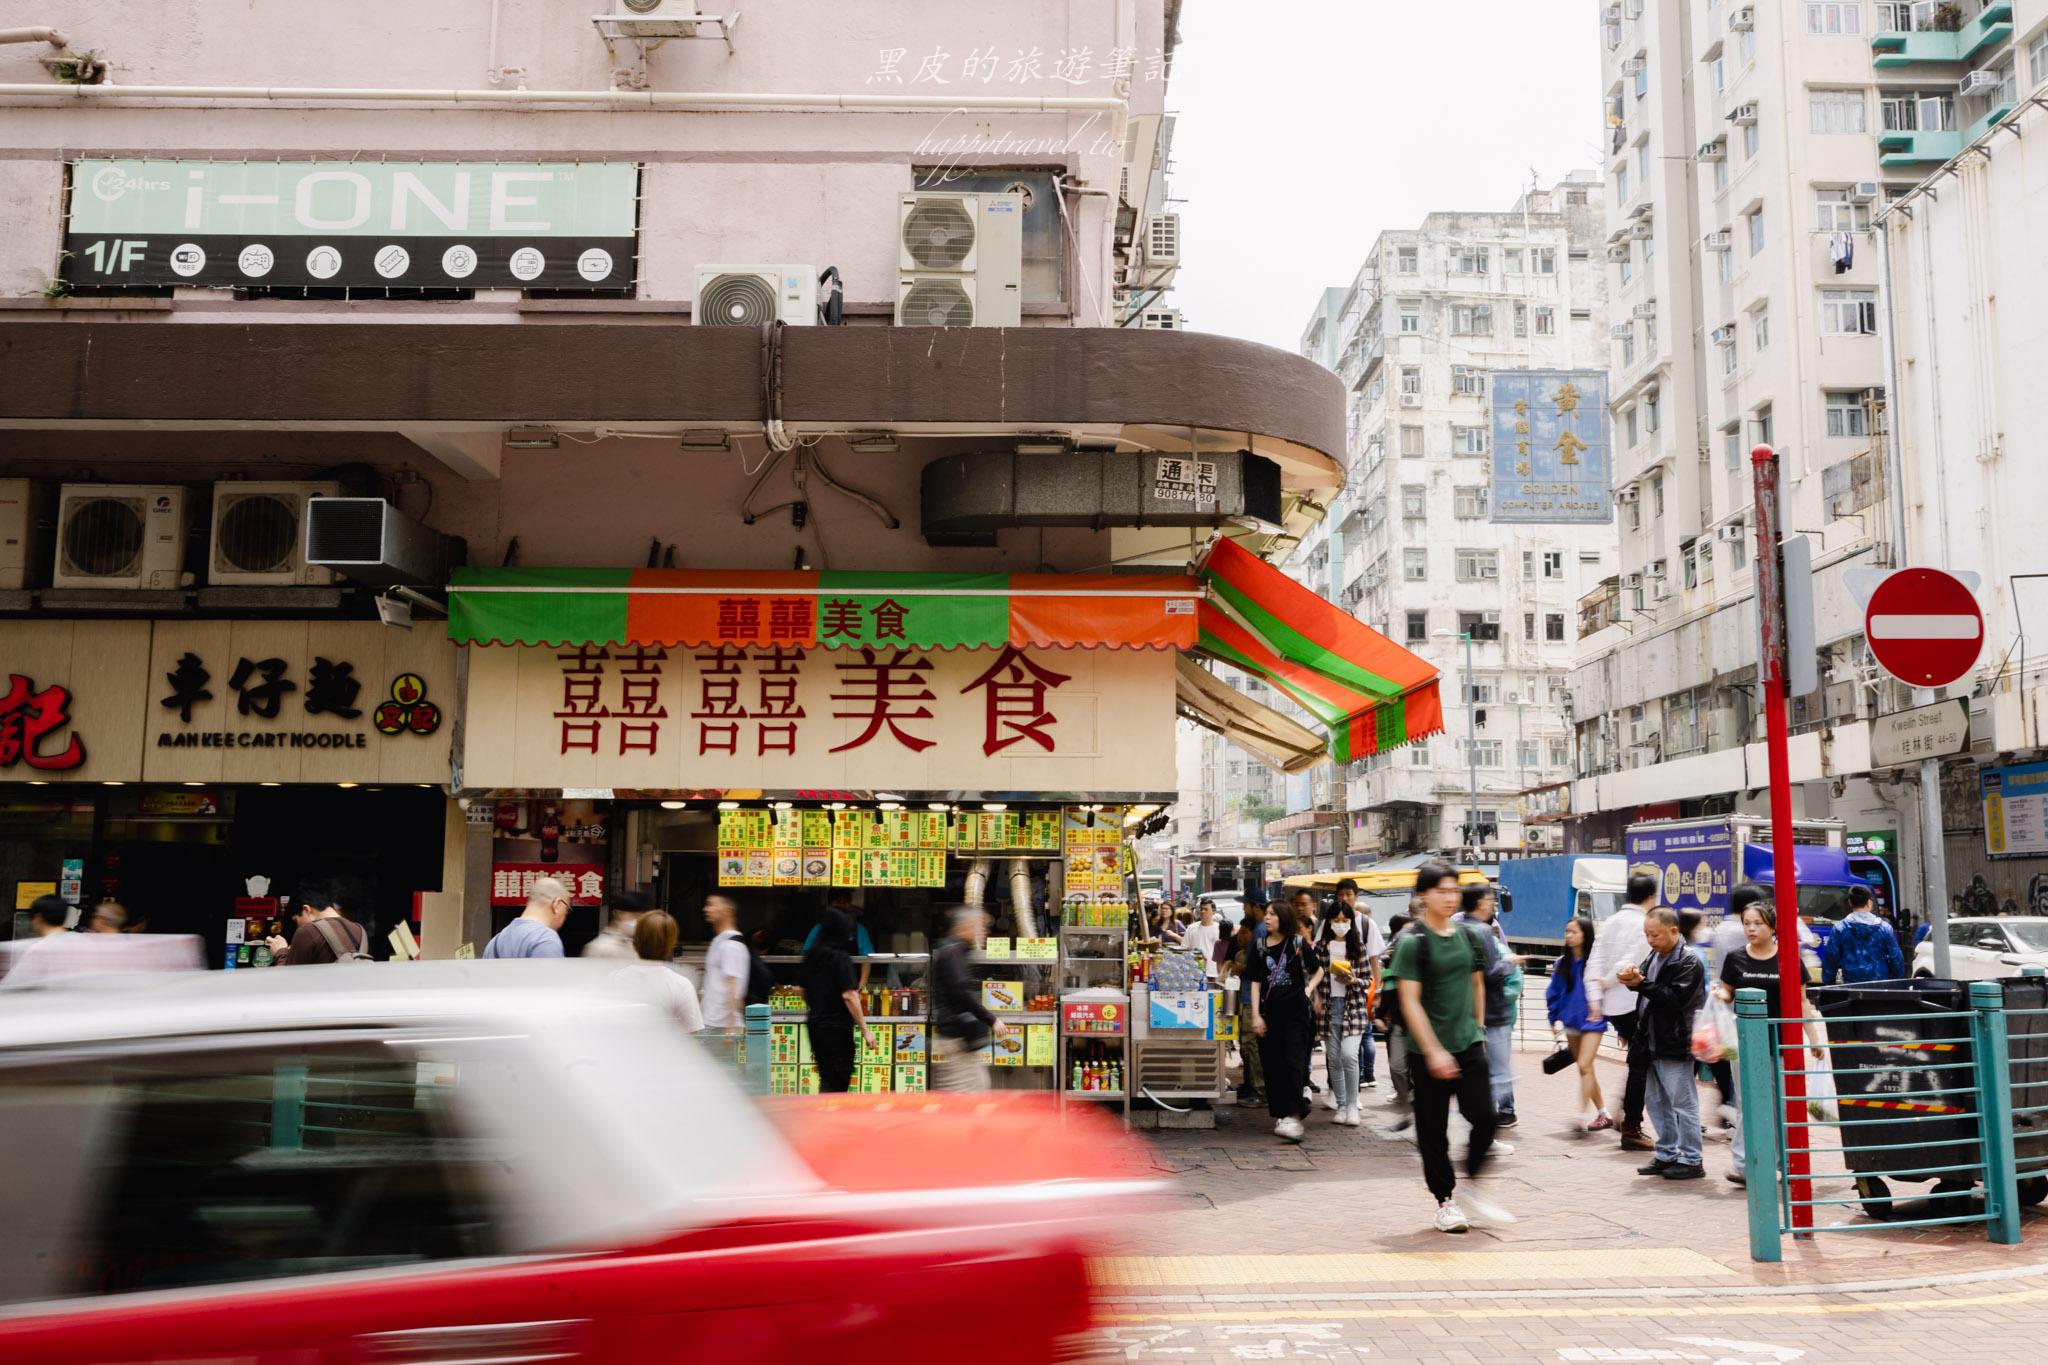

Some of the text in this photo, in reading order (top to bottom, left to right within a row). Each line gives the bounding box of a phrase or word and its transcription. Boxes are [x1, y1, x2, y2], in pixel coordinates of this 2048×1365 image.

[111, 177, 172, 191] 24hrs
[185, 170, 554, 231] i-ONE
[85, 239, 148, 275] 1/F
[1522, 484, 1579, 496] GOLDEN
[1502, 501, 1599, 511] COMPUTER ARCADE
[717, 598, 910, 641] 囍囍美食
[553, 645, 1072, 759] 囍囍美食
[0, 673, 86, 769] 記
[378, 705, 435, 730] 文記
[1919, 710, 1943, 727] Street
[158, 732, 367, 748] MAN KEE CART NOODLE
[1901, 734, 1934, 755] 桂林街
